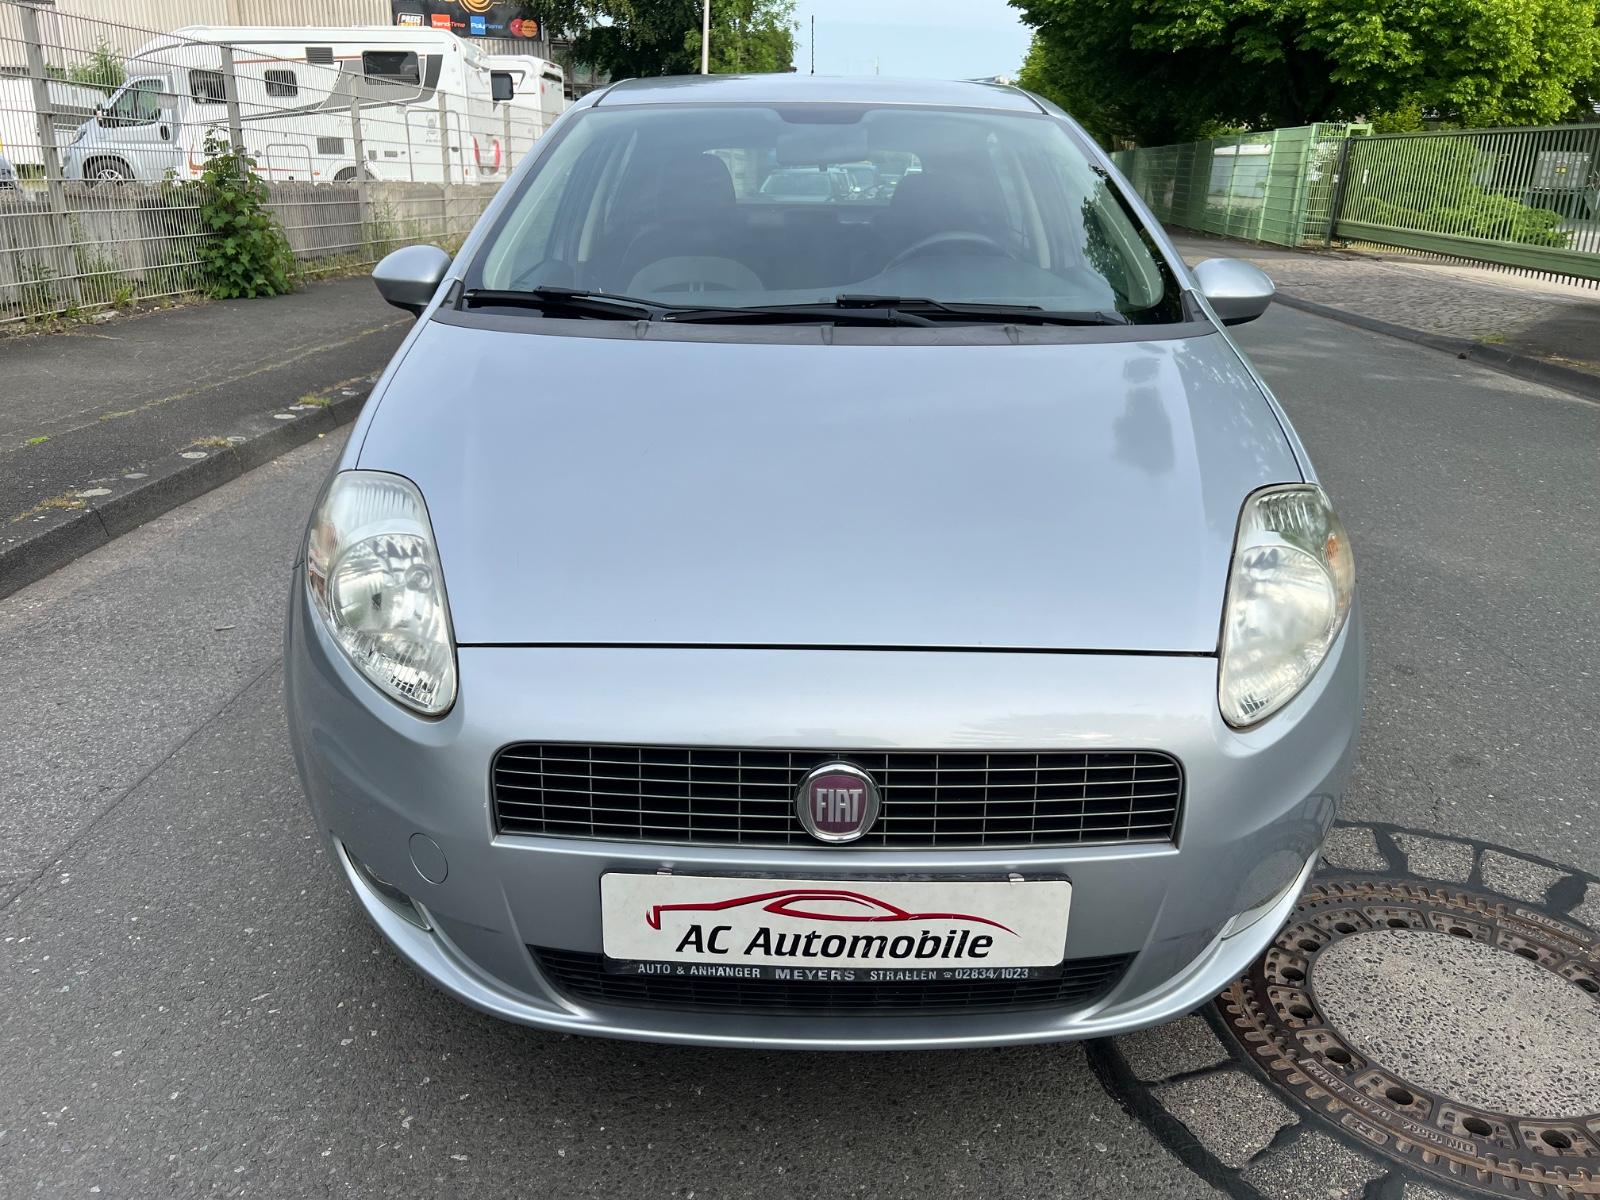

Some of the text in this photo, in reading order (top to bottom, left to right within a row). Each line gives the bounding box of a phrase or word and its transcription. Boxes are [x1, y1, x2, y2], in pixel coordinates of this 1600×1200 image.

[816, 788, 863, 823] FIAT
[676, 924, 993, 959] AC Automobile
[637, 963, 671, 974] AUTO
[676, 966, 685, 975] &
[690, 965, 761, 978] ANHÄNGER
[775, 968, 856, 981] MEYERS
[955, 968, 1029, 980] 02834/1023
